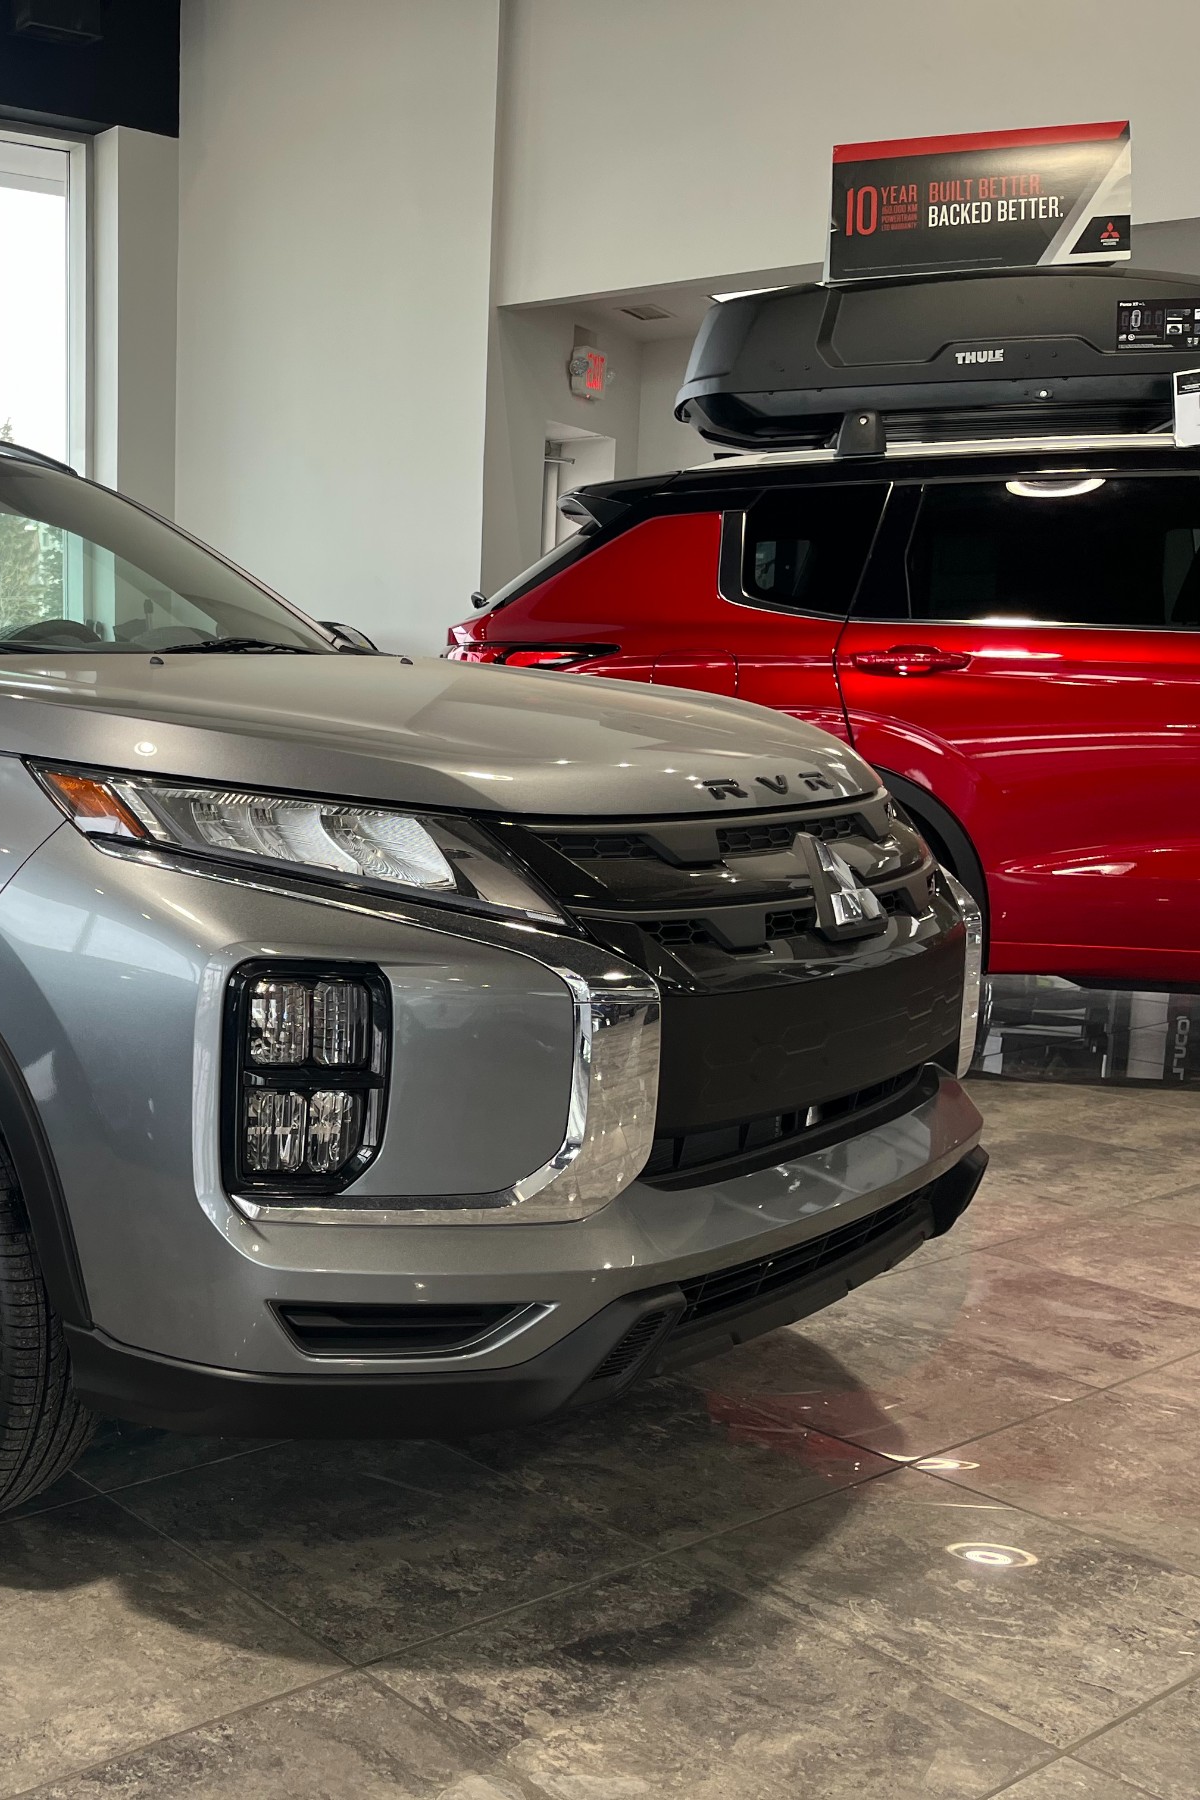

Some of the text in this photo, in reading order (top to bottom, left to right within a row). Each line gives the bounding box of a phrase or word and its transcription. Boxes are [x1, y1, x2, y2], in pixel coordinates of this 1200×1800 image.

[929, 174, 1044, 203] BUILT BETTER.
[846, 184, 917, 236] 10 YEAR
[928, 196, 1064, 227] BACKED BETTER.
[955, 349, 1004, 364] THULE
[702, 771, 834, 800] RVR
